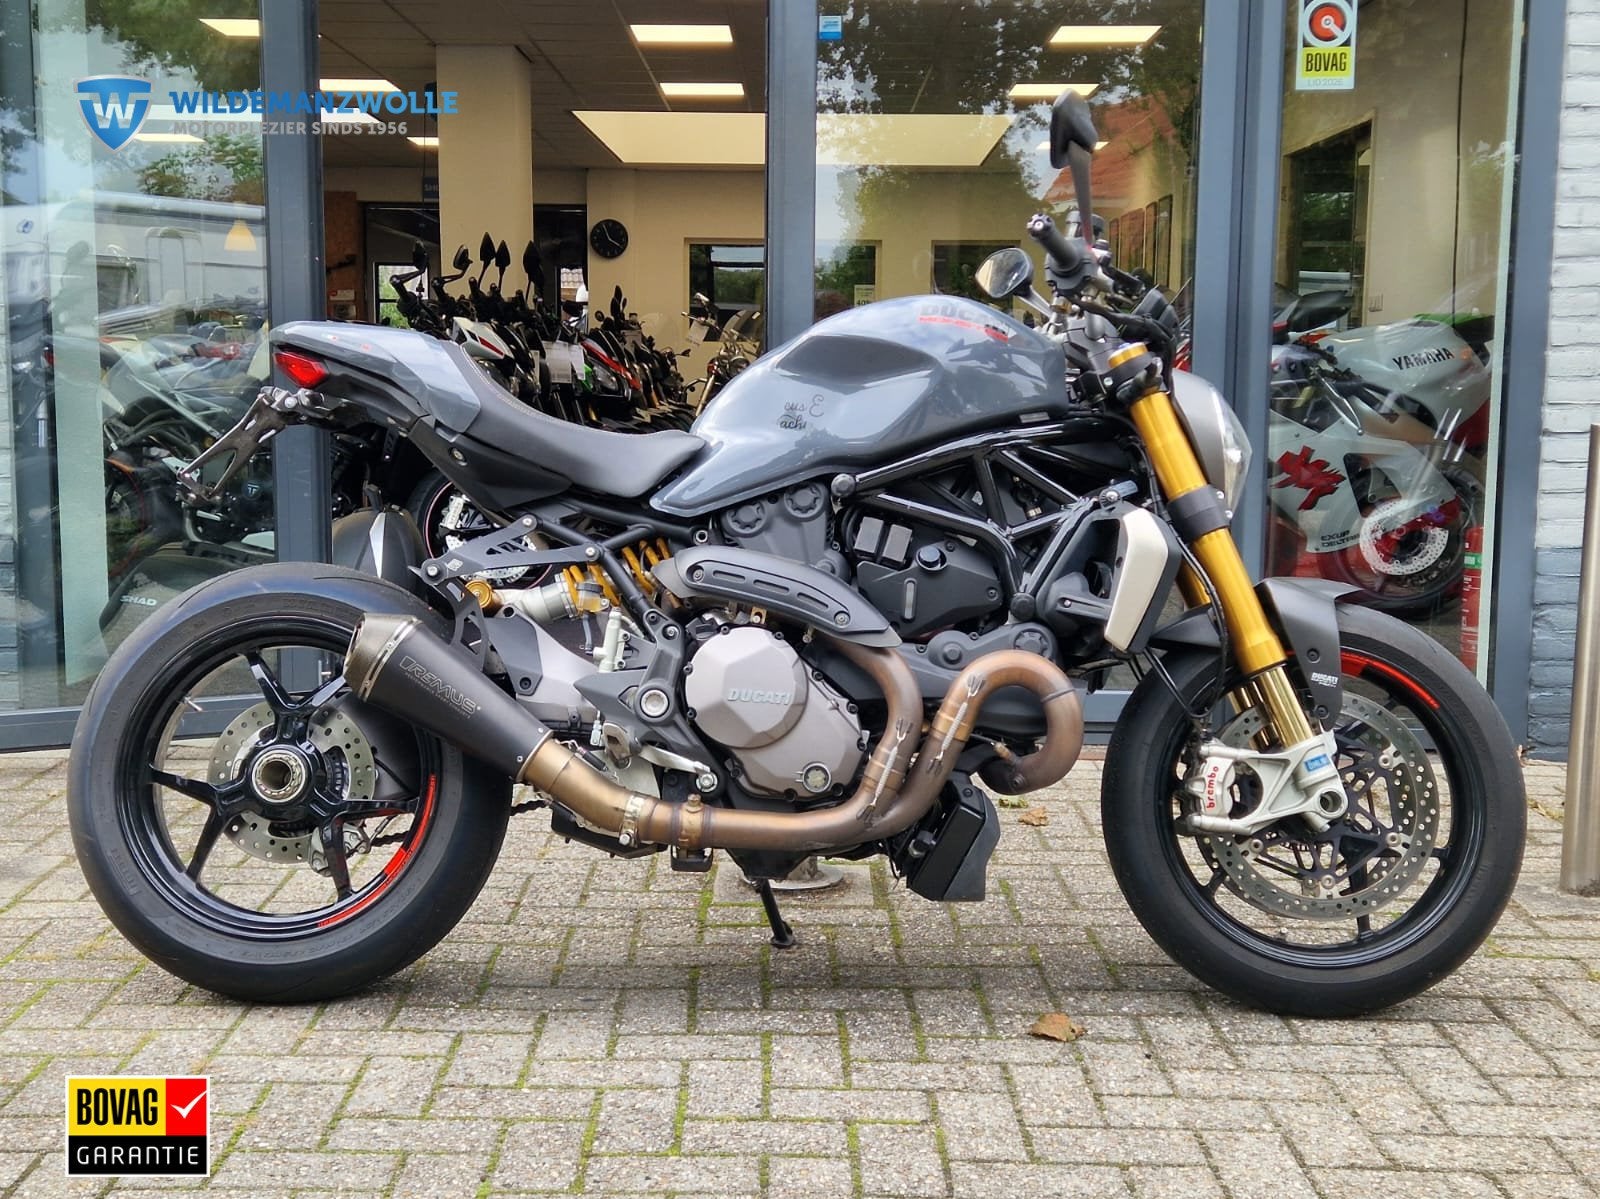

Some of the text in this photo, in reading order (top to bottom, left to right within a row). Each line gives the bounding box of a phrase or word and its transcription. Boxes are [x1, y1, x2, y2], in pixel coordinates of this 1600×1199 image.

[1305, 52, 1347, 72] BOVAG
[1392, 347, 1456, 370] YAMAHA
[120, 595, 158, 606] SHAD
[407, 661, 478, 714] REMUS
[727, 688, 792, 706] DUCATI
[1206, 765, 1220, 809] brembo
